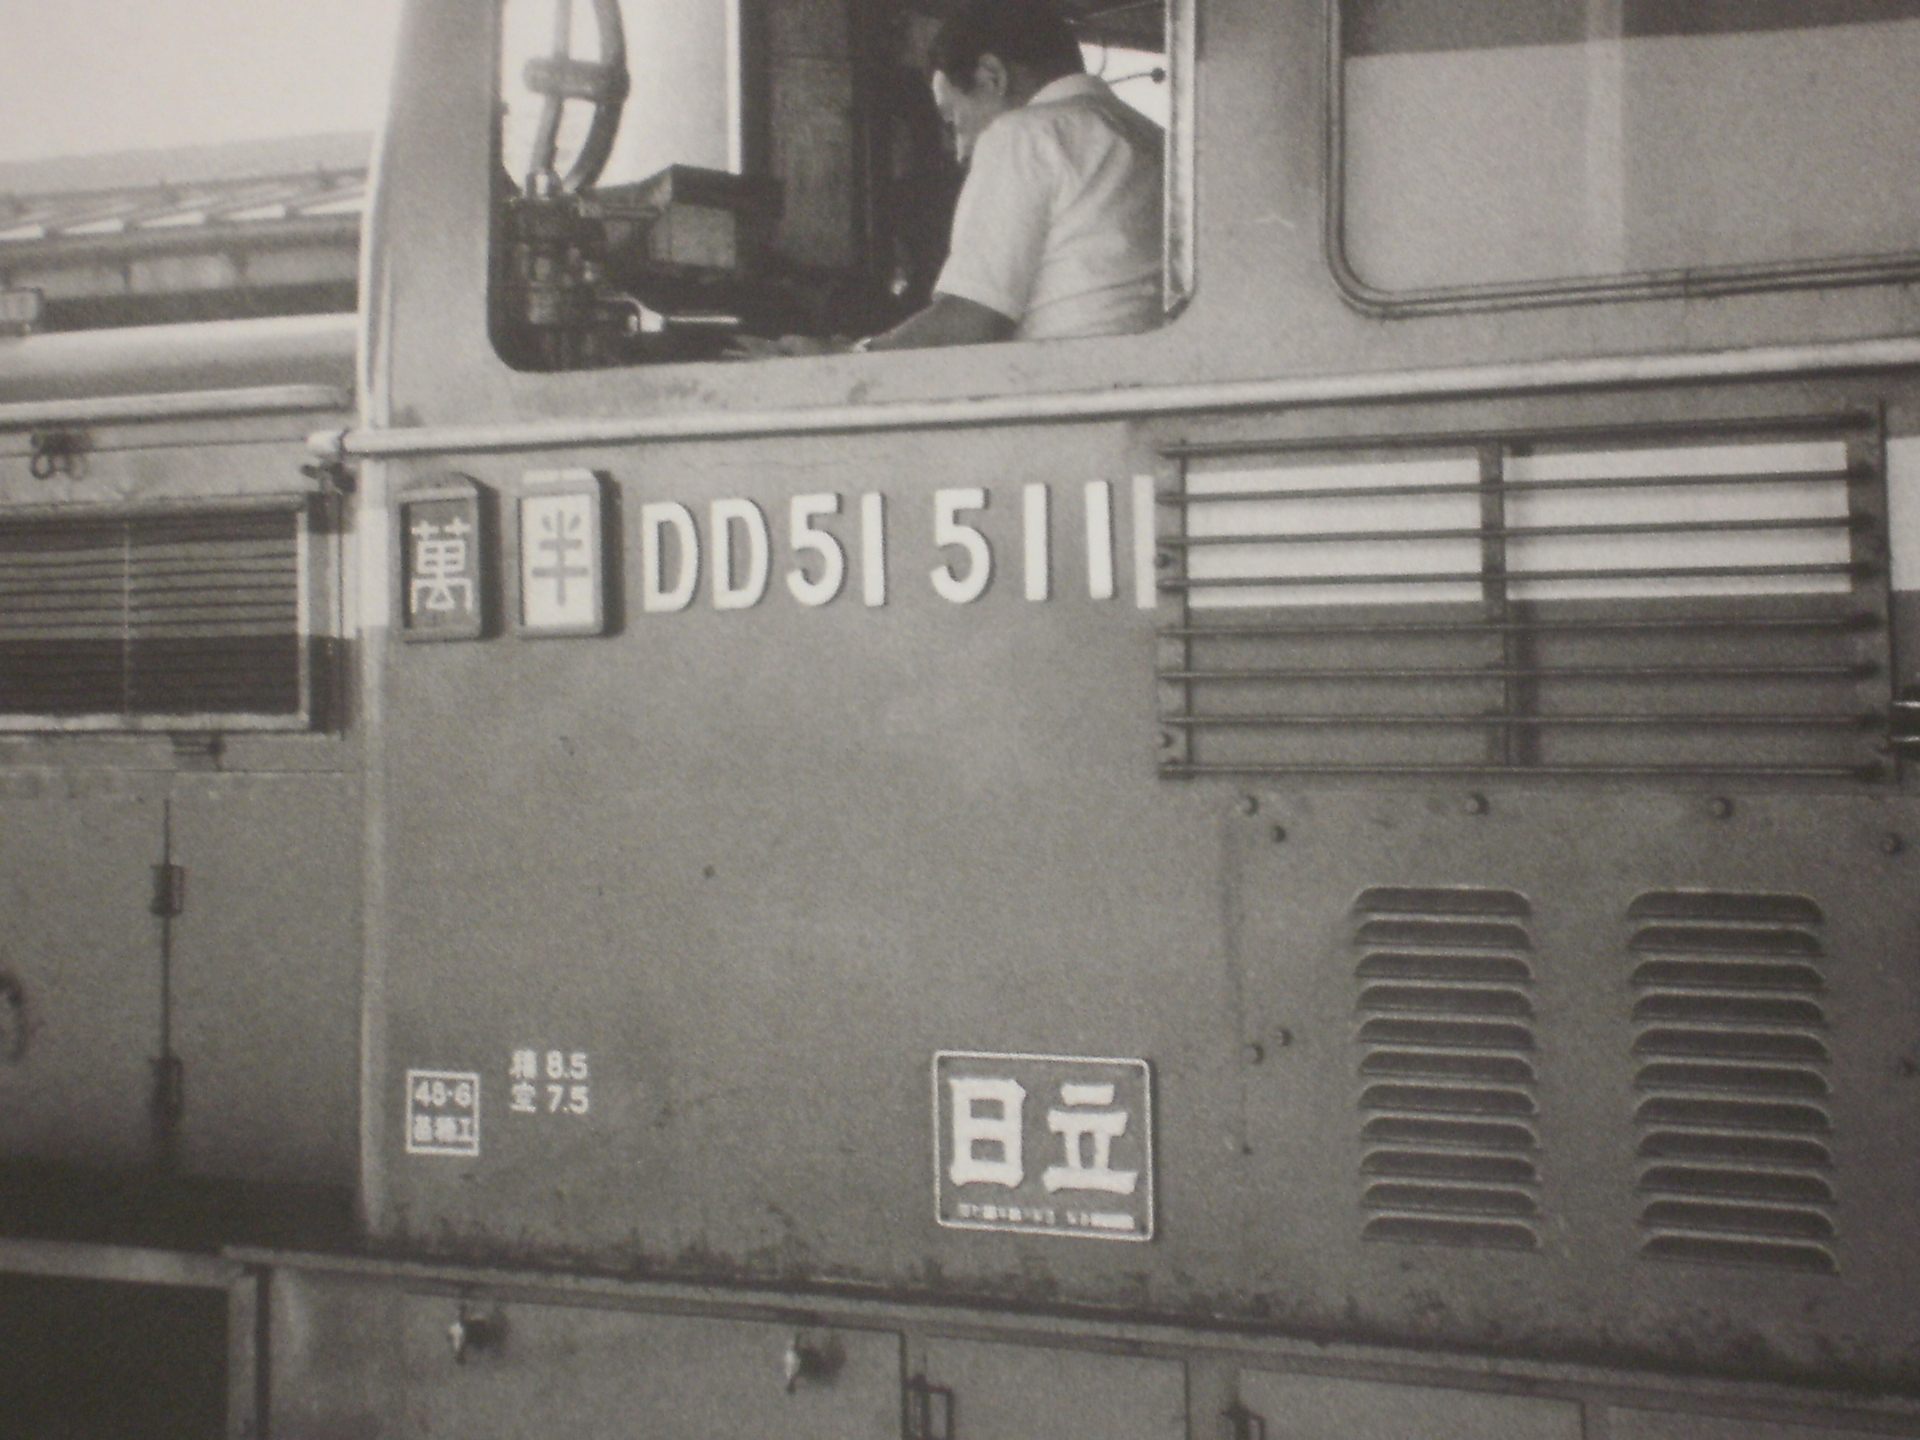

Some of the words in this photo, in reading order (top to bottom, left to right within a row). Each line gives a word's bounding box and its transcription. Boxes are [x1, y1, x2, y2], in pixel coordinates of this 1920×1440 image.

[531, 510, 589, 607] 半
[641, 492, 887, 613] DD51
[930, 481, 1114, 604] 511
[546, 1050, 588, 1080] 8.5
[546, 1084, 589, 1114] 7.5
[949, 1077, 1138, 1195] 日立
